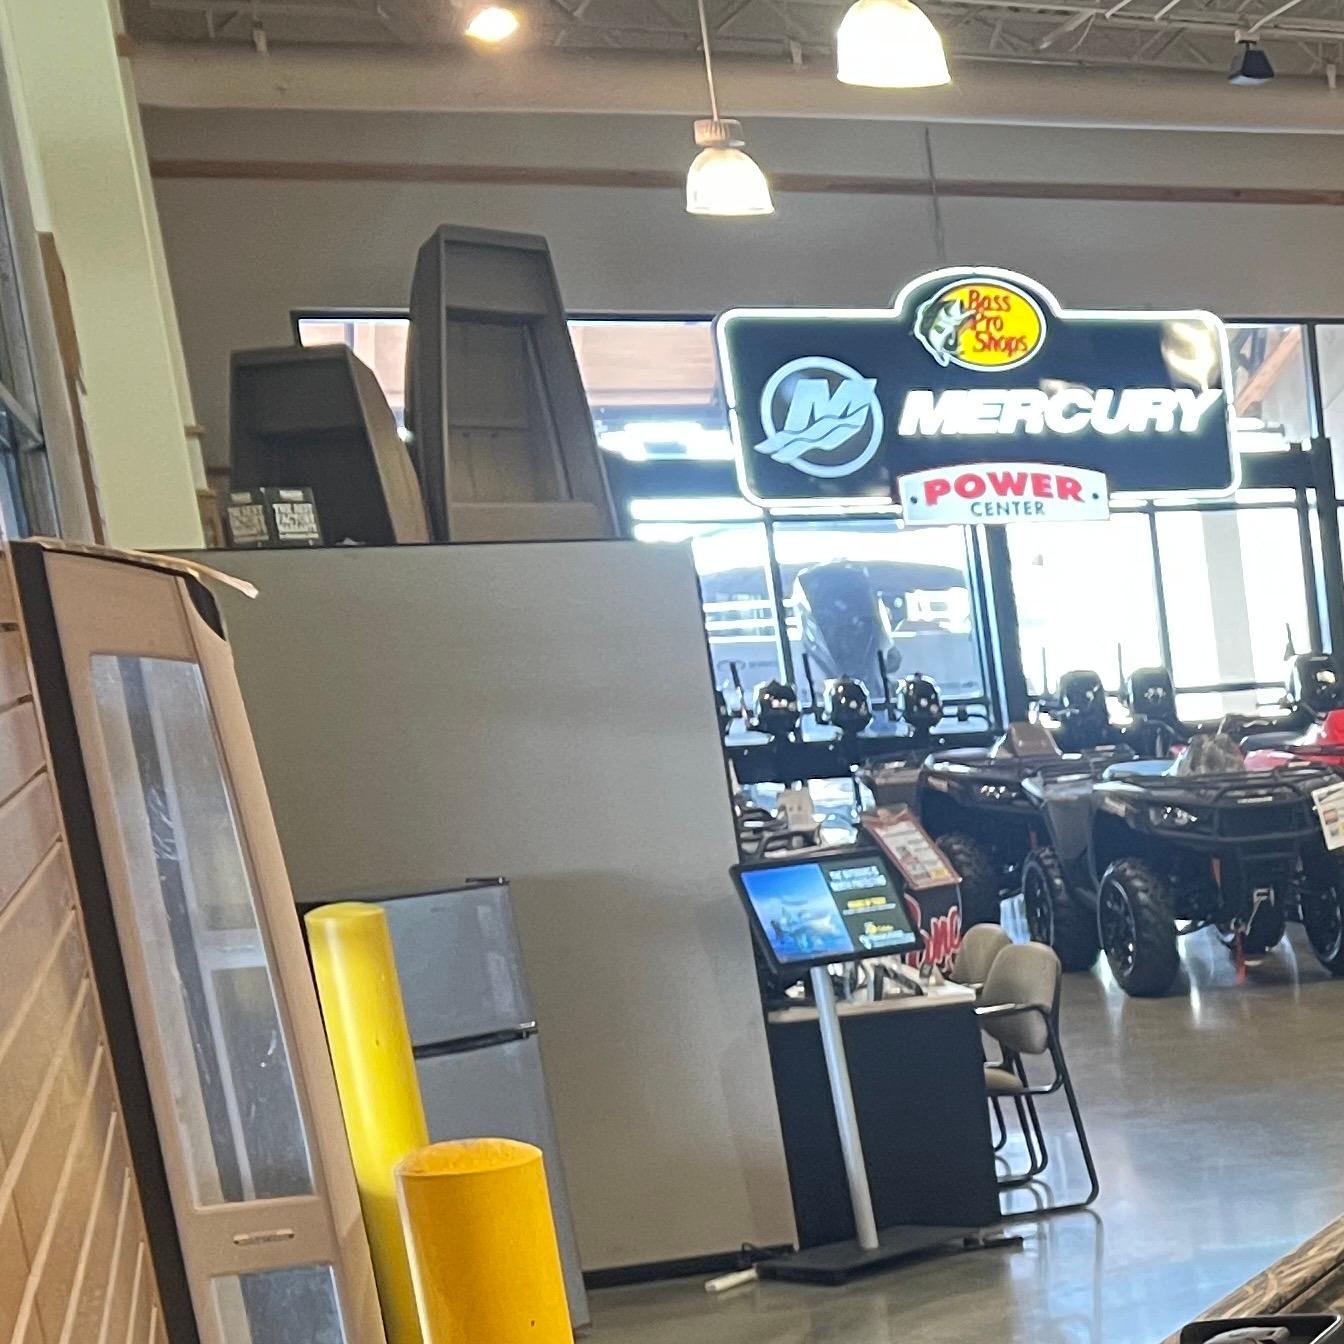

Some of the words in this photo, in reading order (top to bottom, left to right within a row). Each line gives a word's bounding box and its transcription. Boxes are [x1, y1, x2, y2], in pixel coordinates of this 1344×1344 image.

[968, 289, 1011, 312] Bass
[970, 307, 1004, 331] Pro
[972, 331, 1028, 357] Shops
[899, 388, 1224, 436] MERCURY
[924, 471, 1085, 506] POWER
[970, 499, 1047, 518] CENTER
